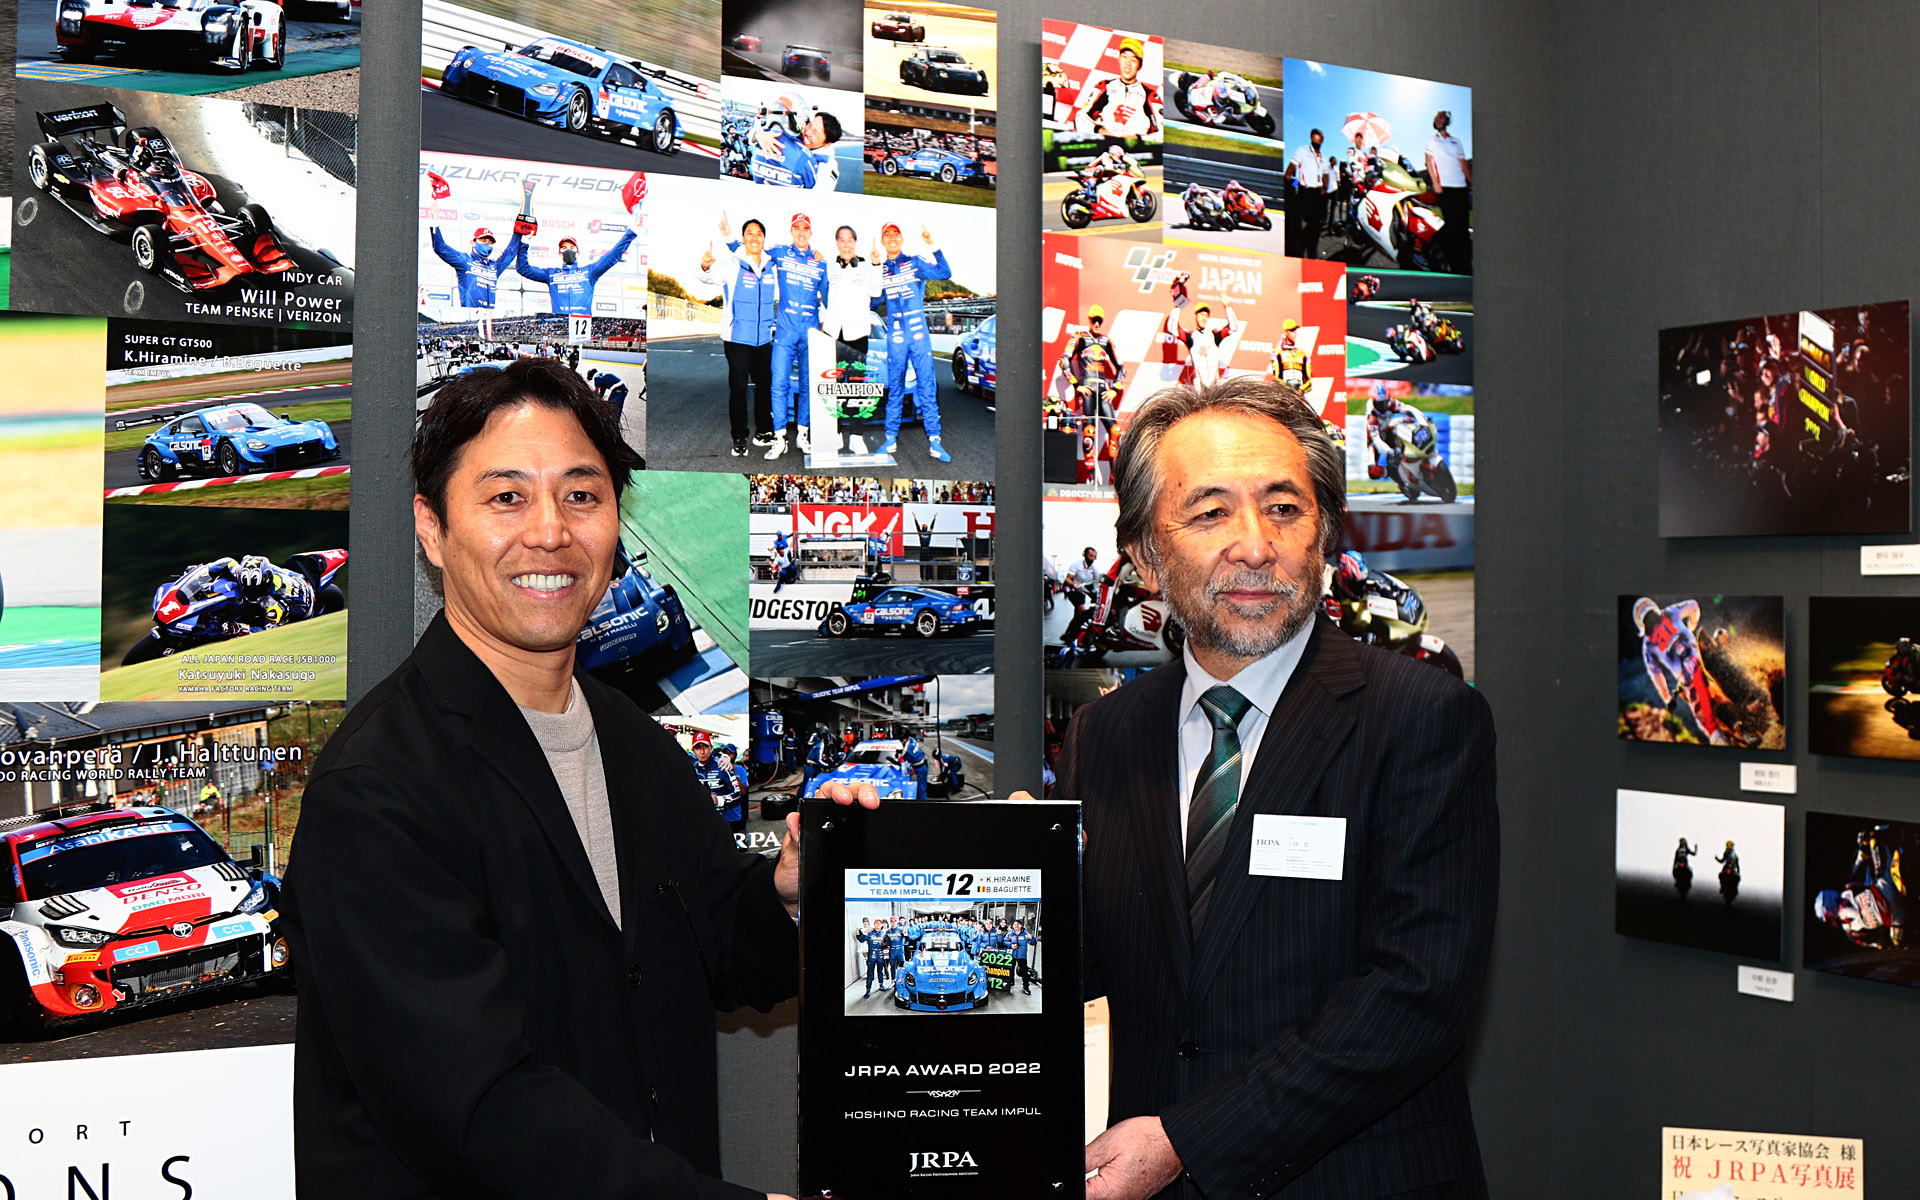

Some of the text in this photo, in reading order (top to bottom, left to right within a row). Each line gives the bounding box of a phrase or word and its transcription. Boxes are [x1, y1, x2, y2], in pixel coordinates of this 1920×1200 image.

[556, 45, 594, 62] BOSCH
[53, 109, 99, 122] verizon
[561, 177, 624, 193] 450K
[541, 219, 575, 229] BOSCH
[282, 271, 343, 286] INDY CAR
[1197, 266, 1263, 295] JAPAN
[241, 288, 342, 310] Will Power
[184, 302, 221, 315] TEAM
[226, 305, 274, 319] PENSKE
[286, 310, 342, 324] VERIZON
[574, 319, 588, 335] 12
[124, 334, 213, 348] SUPER GT GT500
[124, 350, 206, 367] K.Hiramine
[222, 356, 302, 372] B.Baguette
[817, 383, 884, 396] CHAMPION
[799, 510, 877, 538] NGK
[181, 655, 337, 664] ALL JAPAN ROAD RACE JSB1000
[178, 669, 316, 683] Katsuyuki Nakasuga
[0, 744, 122, 766] ovanperä
[180, 742, 303, 762] Halttunen
[21, 769, 71, 781] RACING
[76, 769, 123, 780] WORLD
[127, 768, 167, 779] RALLY
[171, 767, 207, 779] TEAM
[1256, 839, 1280, 847] JRPA
[870, 888, 932, 896] TEAM IMPUL
[946, 873, 974, 896] 12
[123, 883, 202, 905] DENSO
[132, 892, 206, 911] DMG MORI
[222, 924, 245, 935] CCI
[125, 945, 149, 956] CCI
[981, 952, 1013, 966] 2022
[989, 978, 1003, 989] 12
[844, 1062, 1041, 1077] JRPA AWARD 2022
[844, 1107, 1041, 1119] HOSHINO RACING TEAM IMPUL
[1672, 1135, 1856, 1161] 日本レース写真家協会 様
[909, 1150, 978, 1172] JRPA
[1672, 1155, 1692, 1179] 祝
